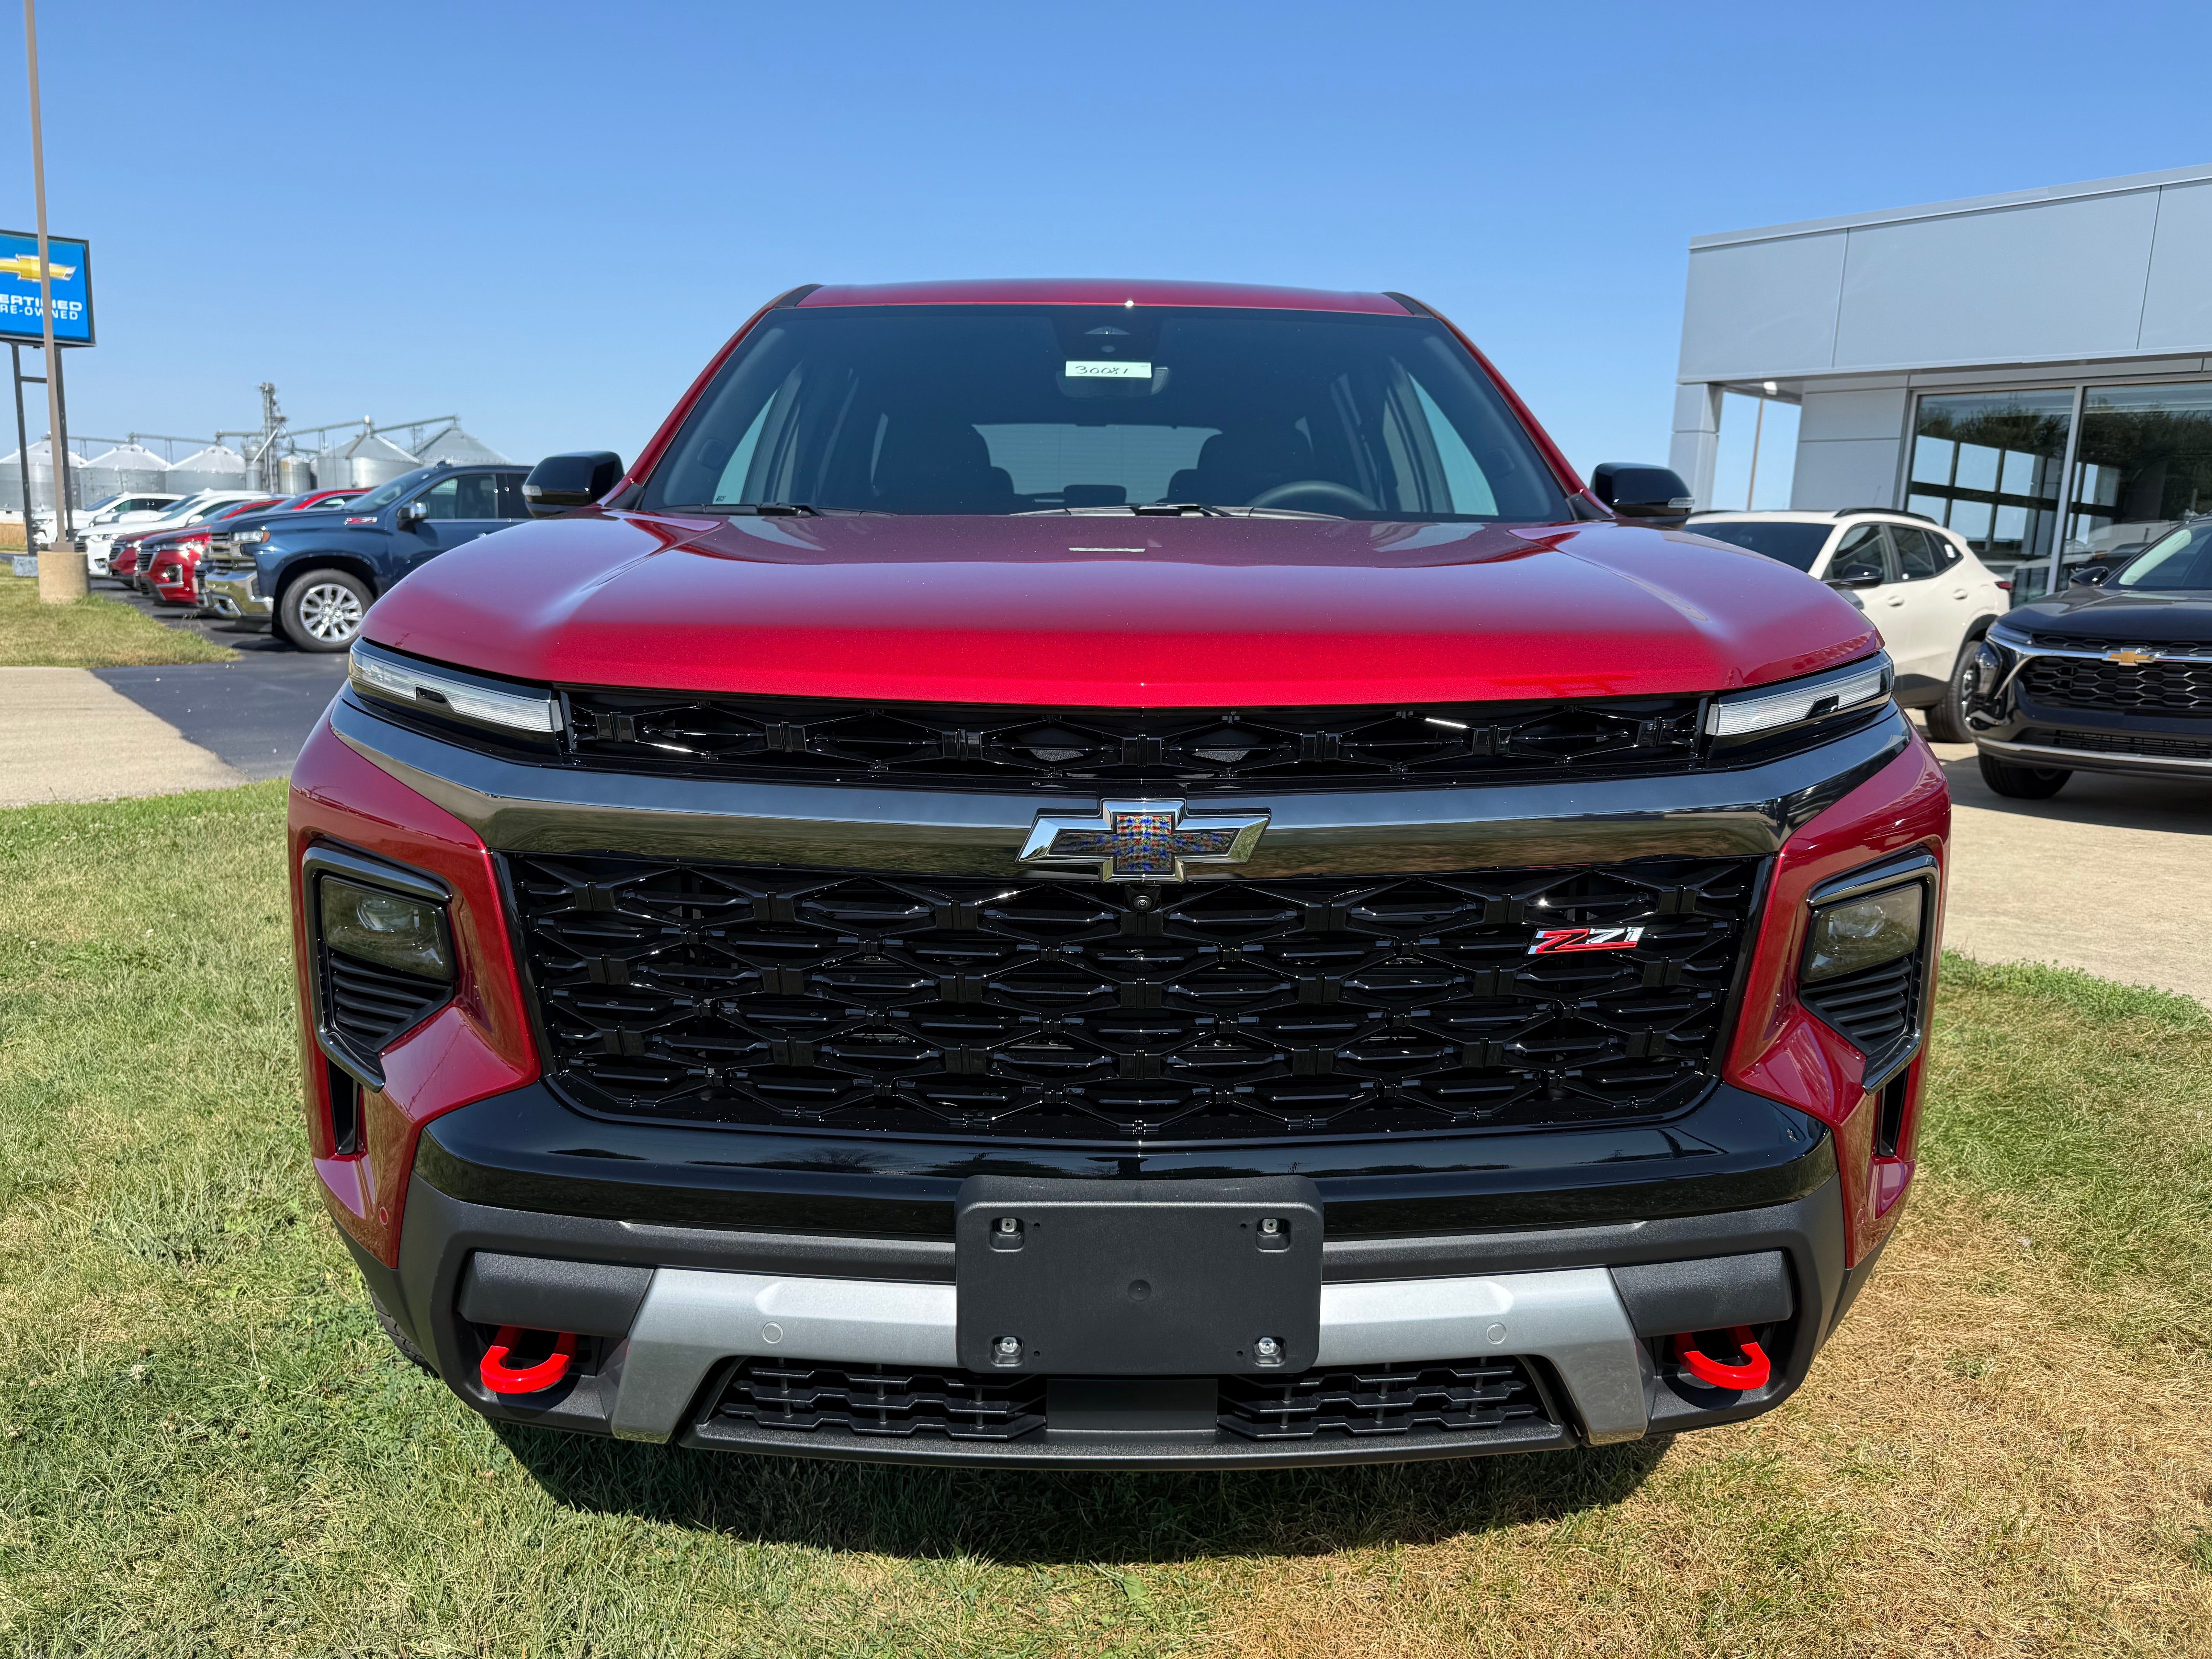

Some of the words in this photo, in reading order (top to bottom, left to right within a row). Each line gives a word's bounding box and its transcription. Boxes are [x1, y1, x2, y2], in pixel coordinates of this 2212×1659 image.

[0, 294, 82, 311] ERTIIED
[1075, 366, 1128, 374] 30081
[1528, 926, 1645, 954] Z71
